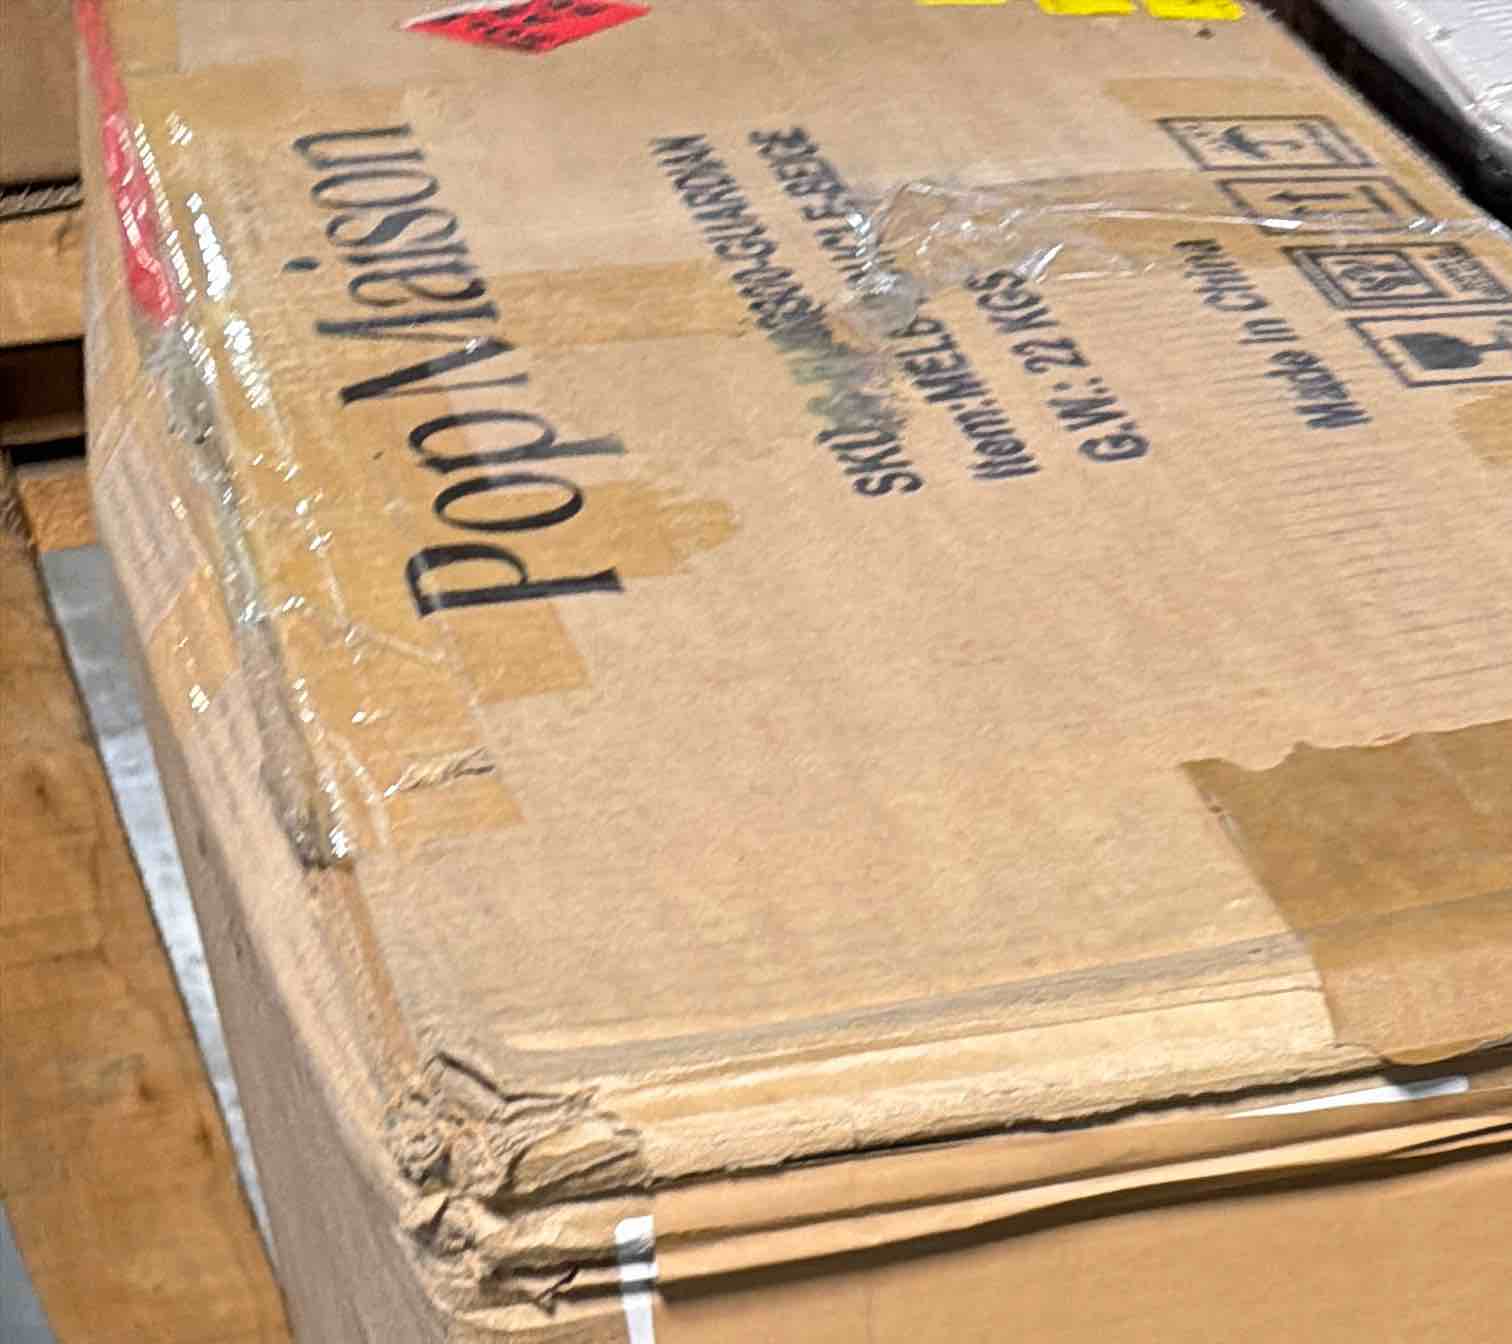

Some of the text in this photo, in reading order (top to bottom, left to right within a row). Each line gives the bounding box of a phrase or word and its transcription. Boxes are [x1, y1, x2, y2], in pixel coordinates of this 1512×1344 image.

[963, 267, 1057, 336] KGS
[1172, 239, 1269, 312] China
[1012, 334, 1090, 375] 22
[1264, 350, 1374, 429] Made
